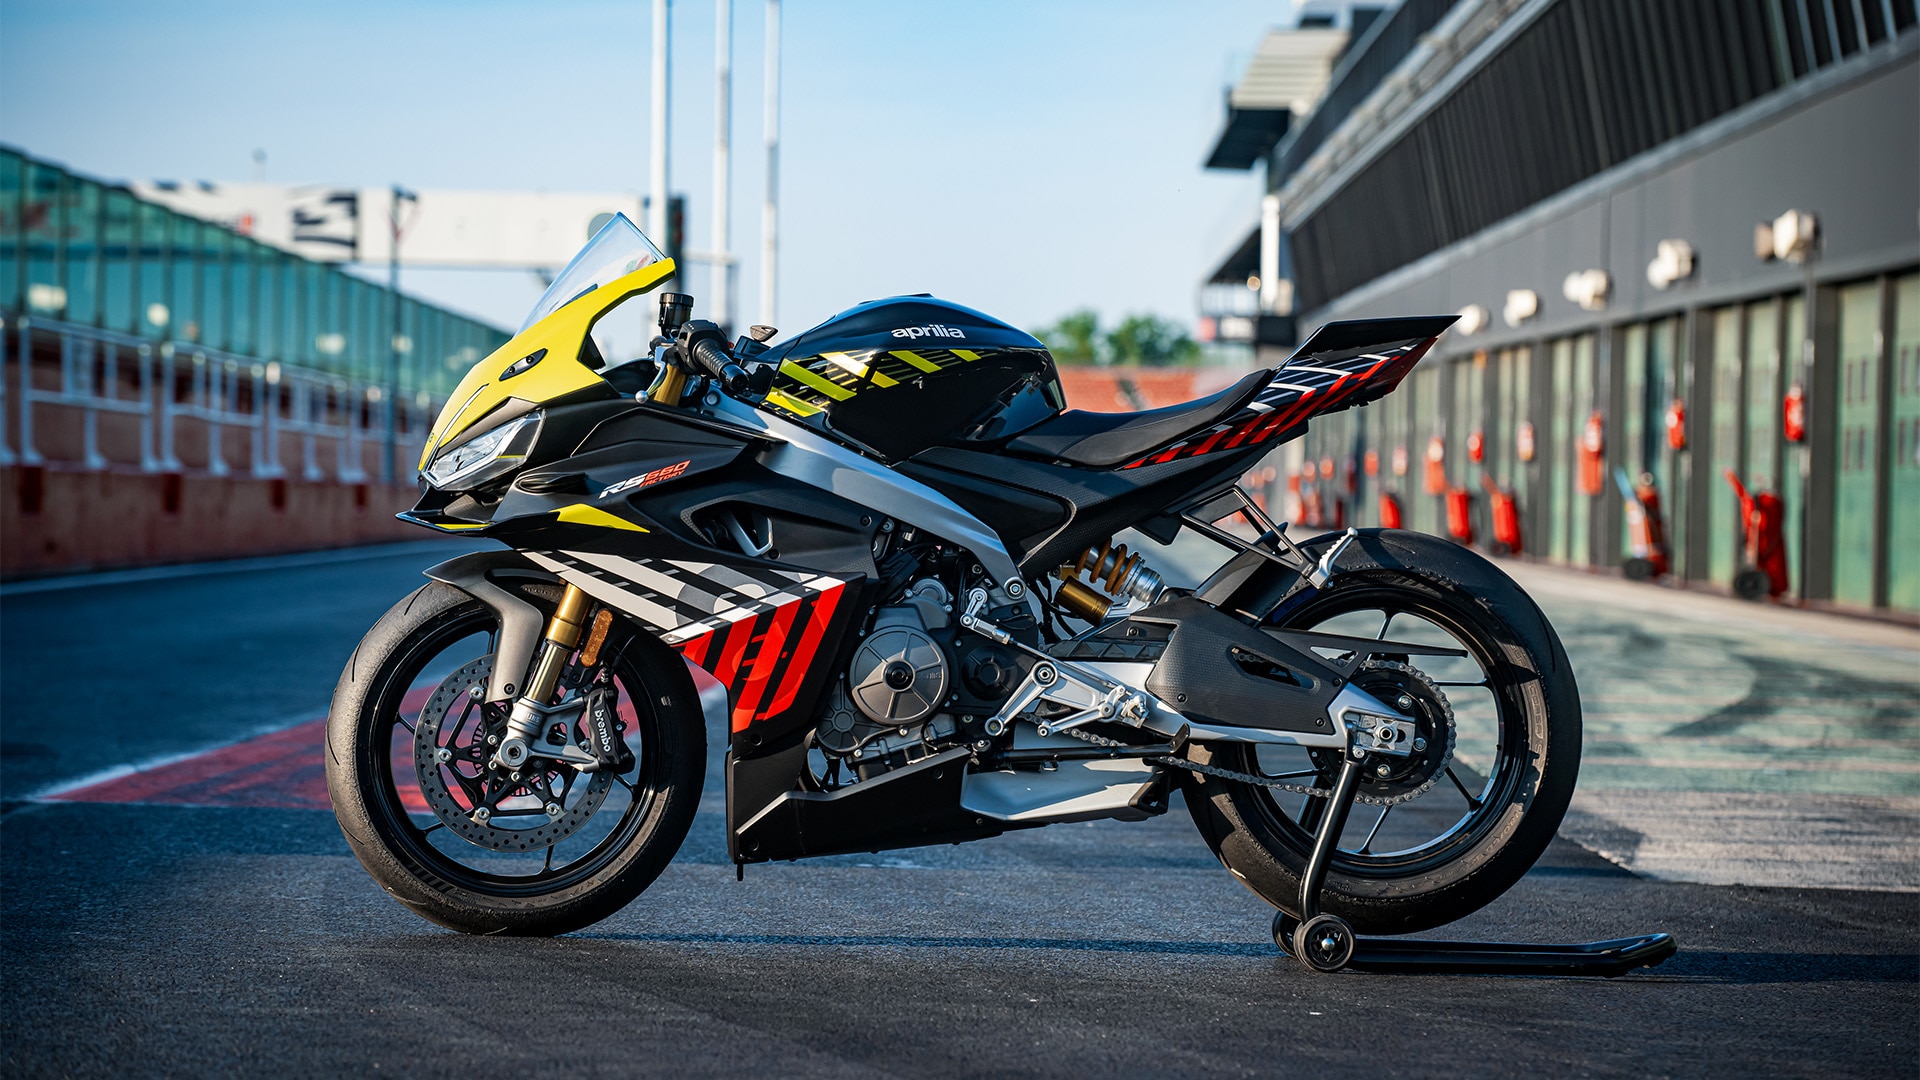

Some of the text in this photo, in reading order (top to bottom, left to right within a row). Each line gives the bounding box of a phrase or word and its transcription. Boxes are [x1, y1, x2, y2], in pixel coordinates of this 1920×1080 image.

[890, 323, 966, 340] aprilia
[639, 469, 686, 489] FACTORY
[594, 709, 612, 752] brembo
